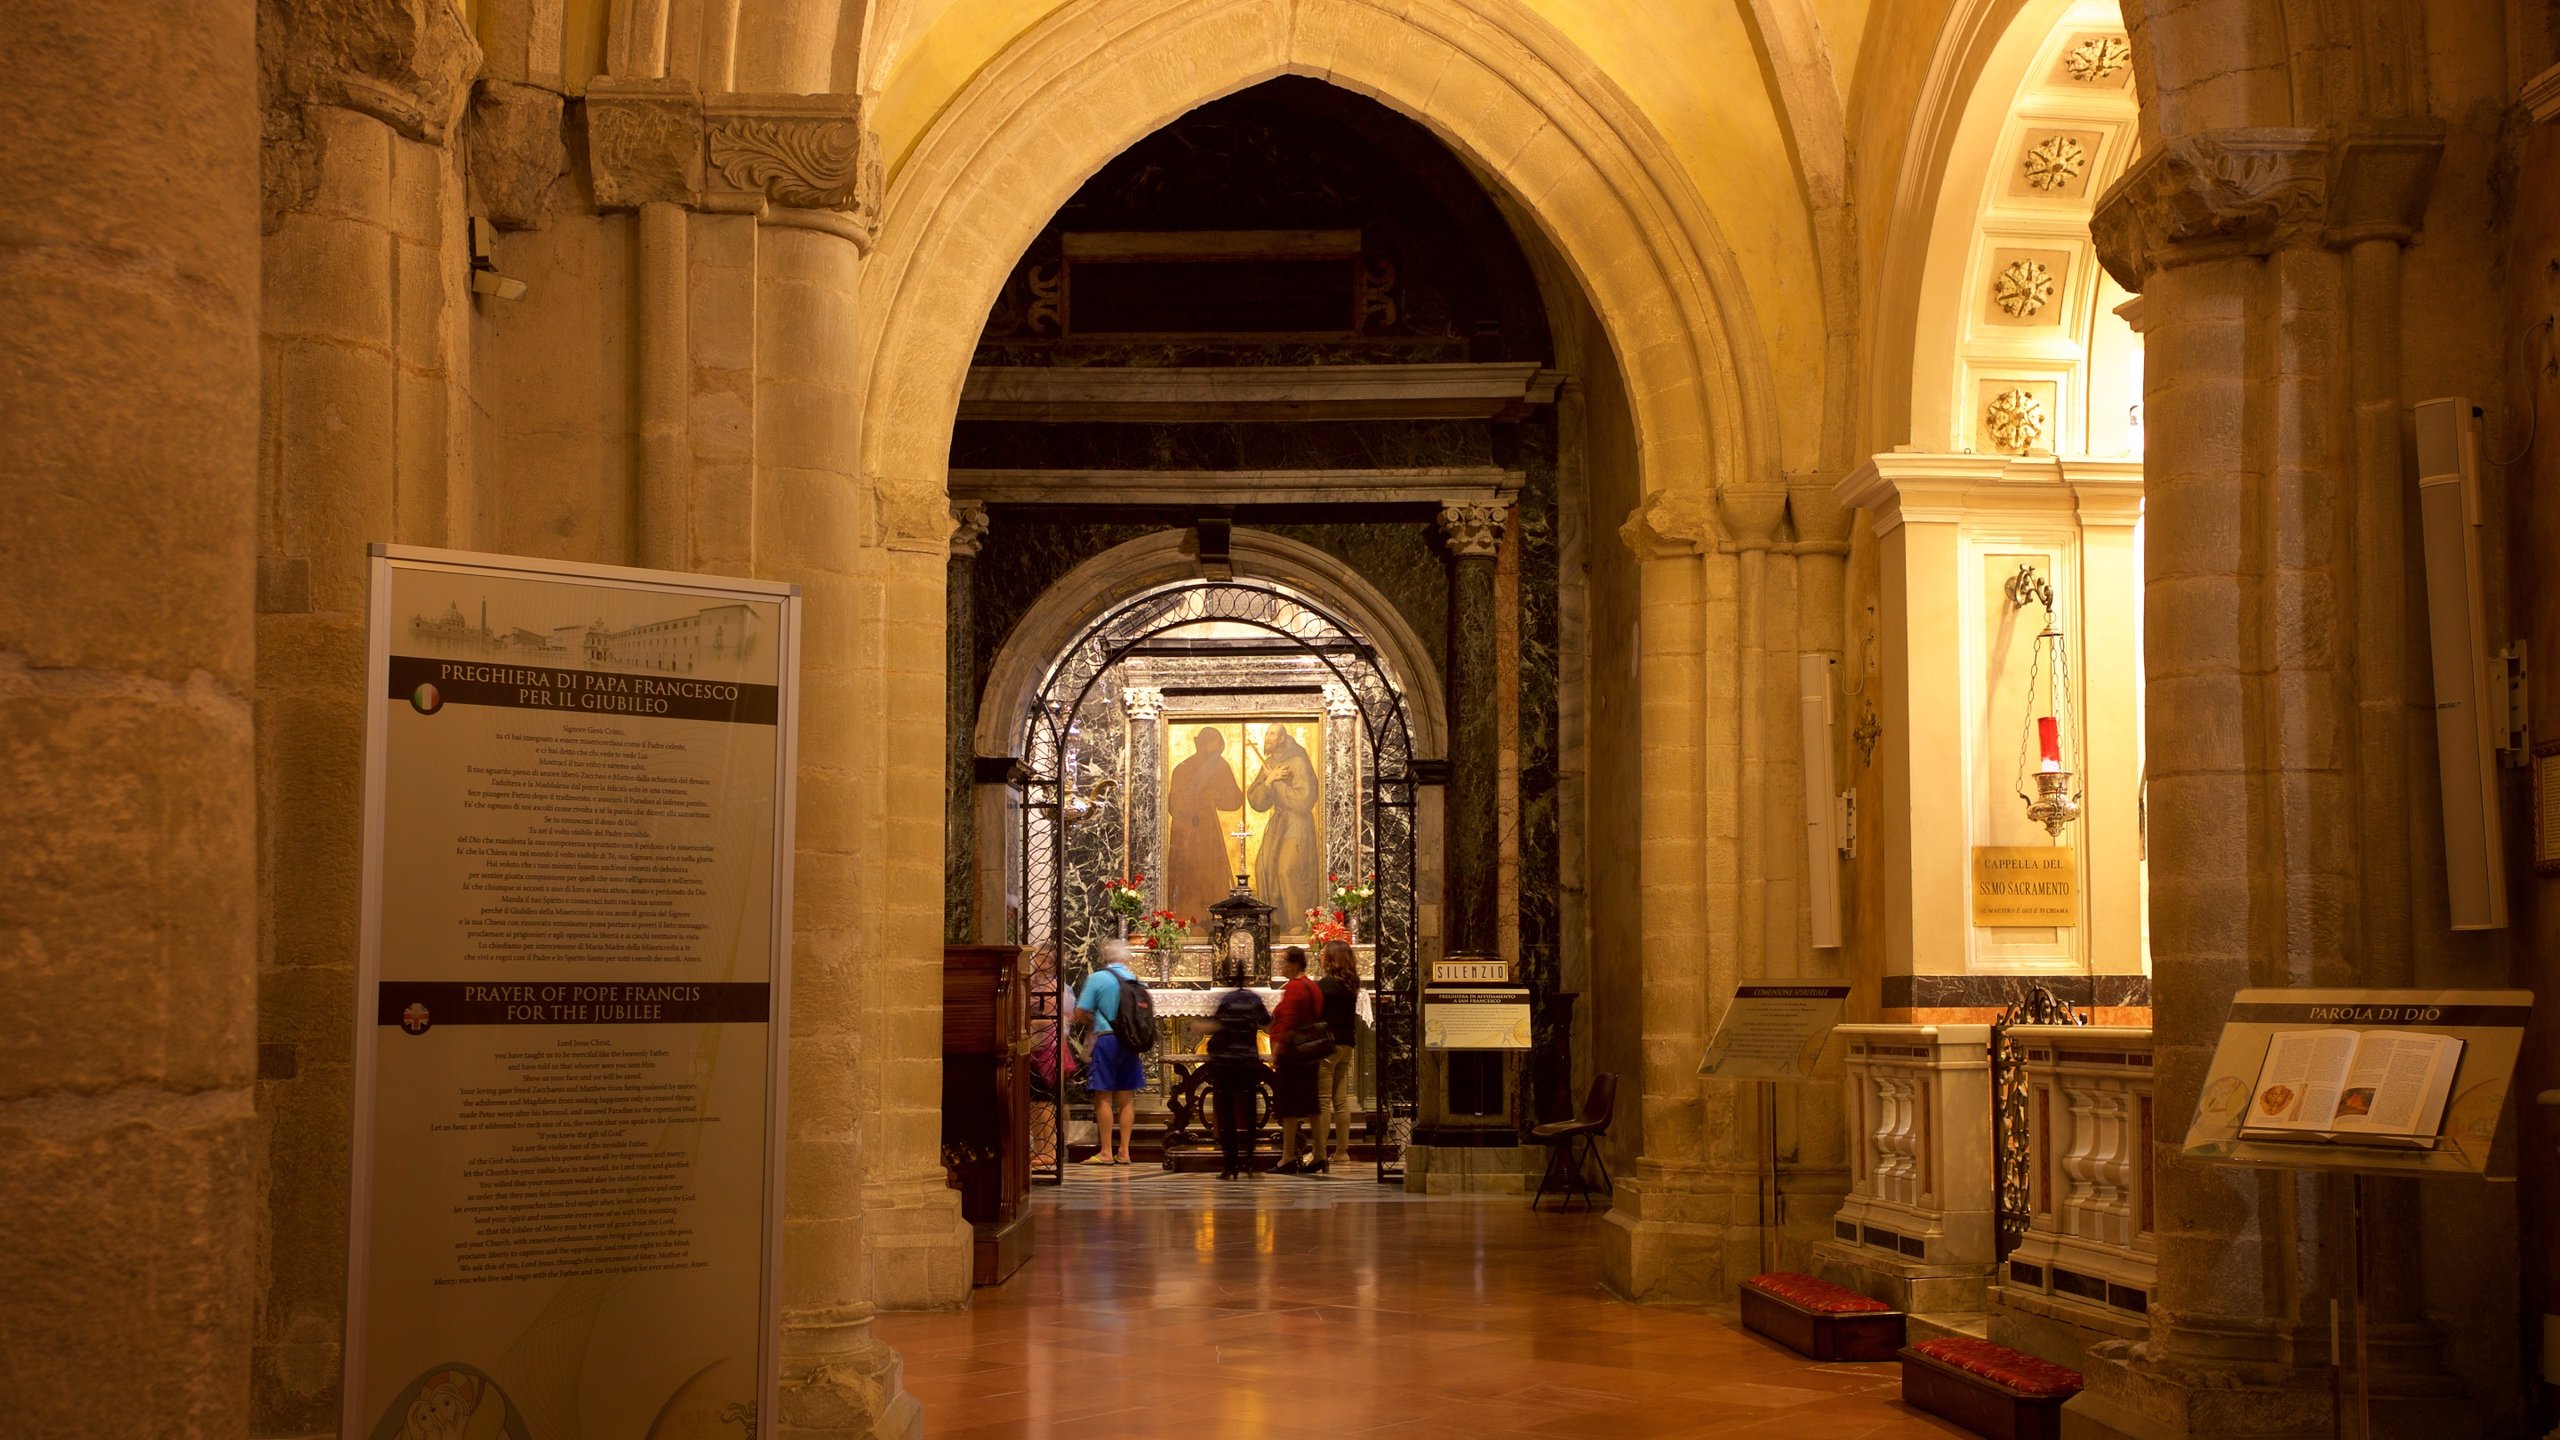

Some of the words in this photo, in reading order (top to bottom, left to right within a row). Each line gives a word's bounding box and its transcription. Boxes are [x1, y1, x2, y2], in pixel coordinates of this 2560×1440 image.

[441, 665, 550, 687] PREGHIERA
[557, 674, 578, 690] DI
[585, 676, 629, 693] PAPA
[635, 679, 738, 701] FRANCESCO
[519, 690, 553, 706] PER
[559, 693, 575, 707] IL
[581, 694, 668, 713] GIUBILEO
[1985, 860, 2038, 869] CAPPELLA
[2043, 860, 2063, 869] DEL
[2008, 882, 2069, 895] SACRAMENTO
[1438, 966, 1503, 978] SILENZIO
[465, 987, 536, 1001] PRAYER
[542, 987, 567, 1001] OF
[573, 987, 618, 1001] POPE
[625, 987, 700, 1001] FRANCIS
[507, 1005, 546, 1020] FOR
[551, 1005, 588, 1020] THE
[594, 1005, 662, 1022] JUBILEE
[2310, 1008, 2373, 1020] PAROLA
[2379, 1008, 2399, 1020] DI
[2405, 1008, 2440, 1021] DIO
